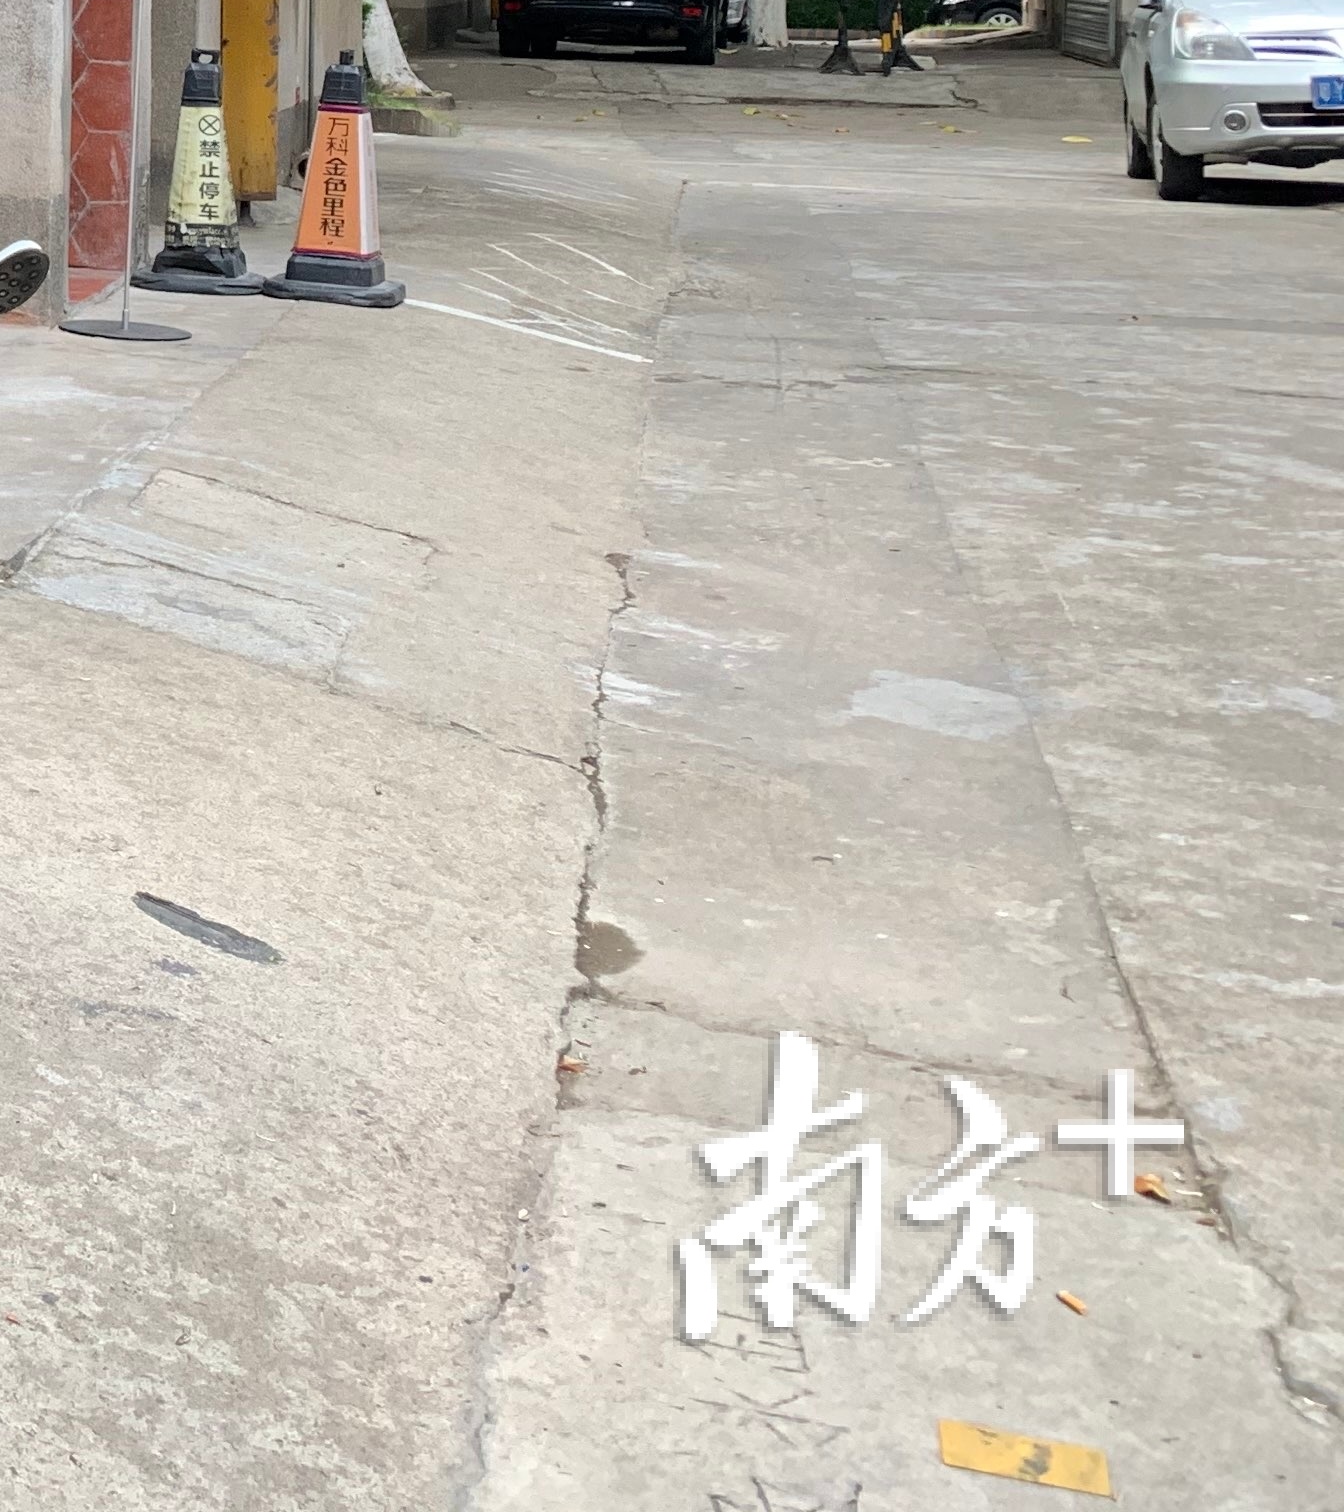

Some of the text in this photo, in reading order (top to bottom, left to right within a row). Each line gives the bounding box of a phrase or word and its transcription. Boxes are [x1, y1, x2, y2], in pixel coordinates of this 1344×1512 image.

[198, 140, 221, 220] 禁止停车
[319, 116, 350, 238] 万科金色里程
